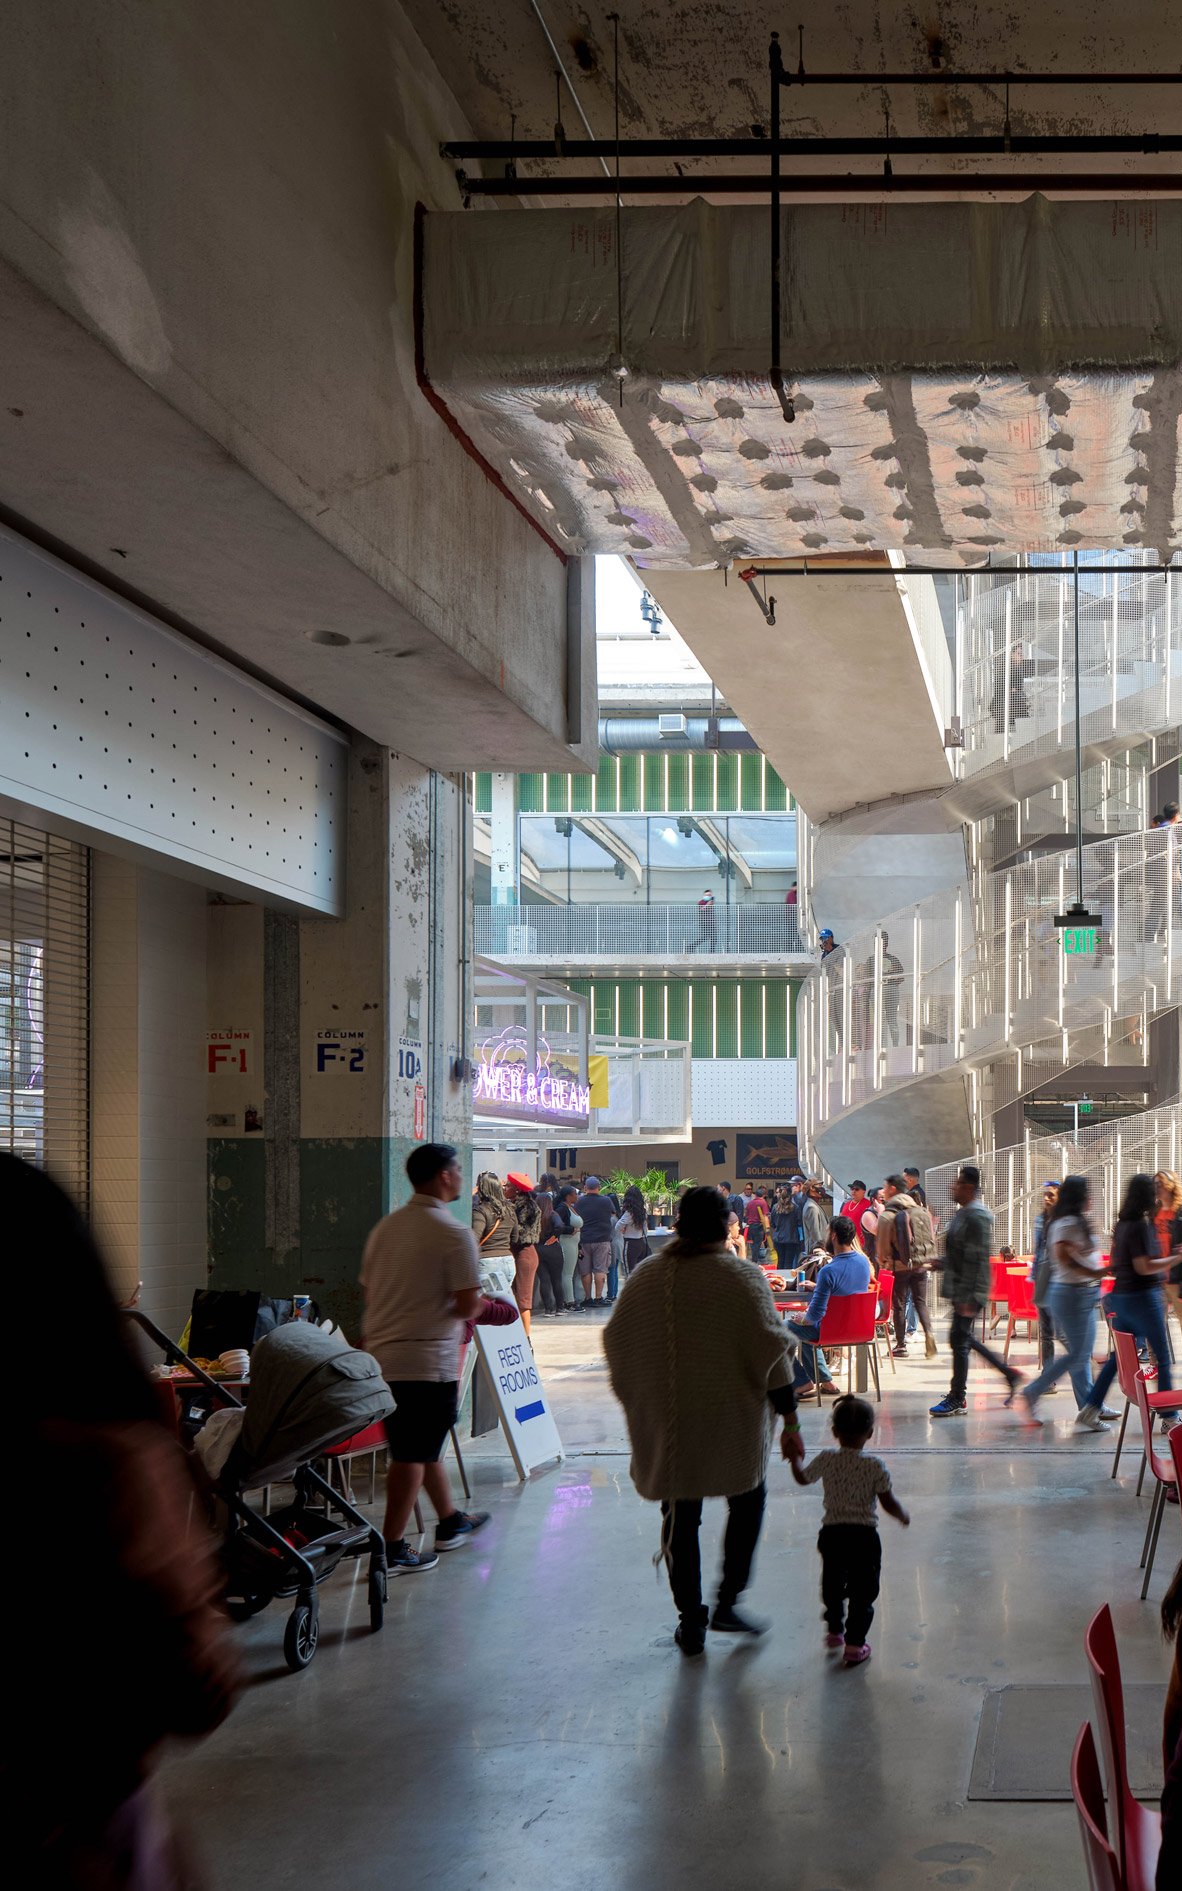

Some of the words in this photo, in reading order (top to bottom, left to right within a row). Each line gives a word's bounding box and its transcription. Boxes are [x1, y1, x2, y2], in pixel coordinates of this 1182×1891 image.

[1064, 929, 1096, 954] EXIT
[317, 1031, 364, 1039] COLUMN
[399, 1037, 422, 1048] COLUMN
[526, 1073, 538, 1105] &
[540, 1077, 590, 1114] CREAM
[498, 1344, 525, 1369] REST
[499, 1366, 538, 1395] ROOMS
